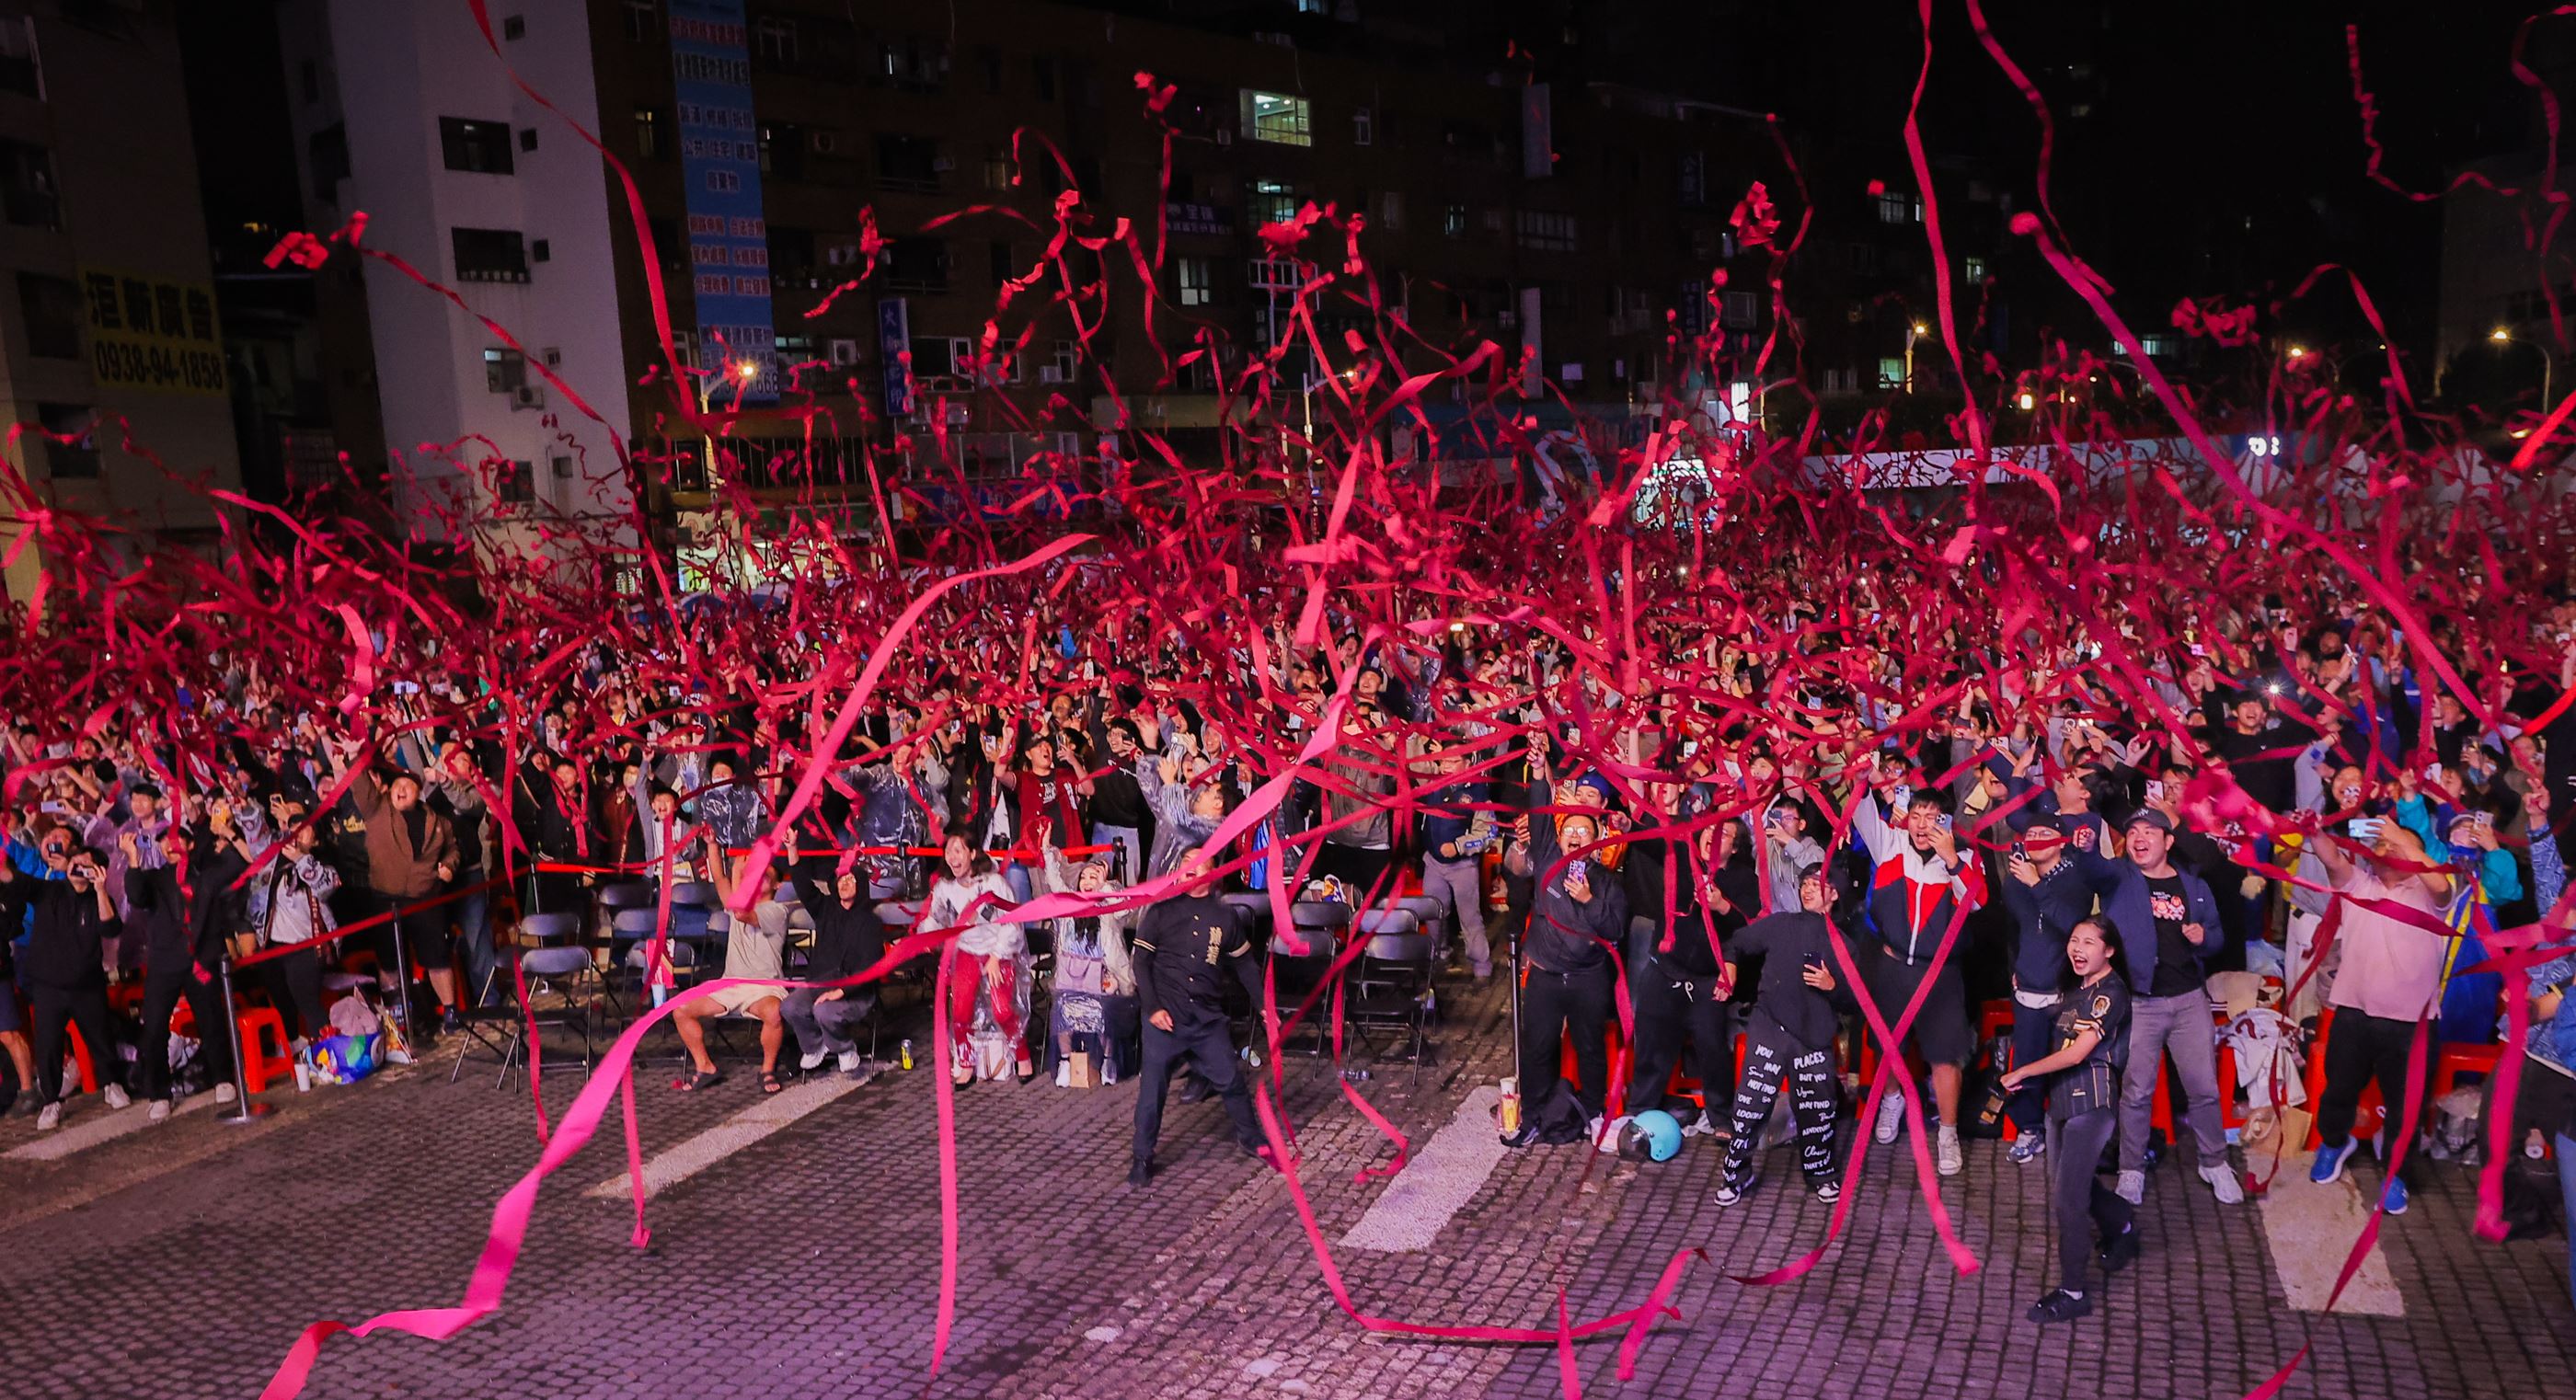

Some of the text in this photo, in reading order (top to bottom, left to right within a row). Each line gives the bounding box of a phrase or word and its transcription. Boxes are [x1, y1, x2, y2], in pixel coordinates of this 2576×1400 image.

[95, 339, 224, 391] 0938-94-1858
[1754, 1043, 1774, 1059] YOU
[1793, 1050, 1826, 1070] PLACES
[1747, 1078, 1763, 1092] NOT
[1799, 1073, 1827, 1084] BUT YOU
[1737, 1093, 1753, 1105] OVE
